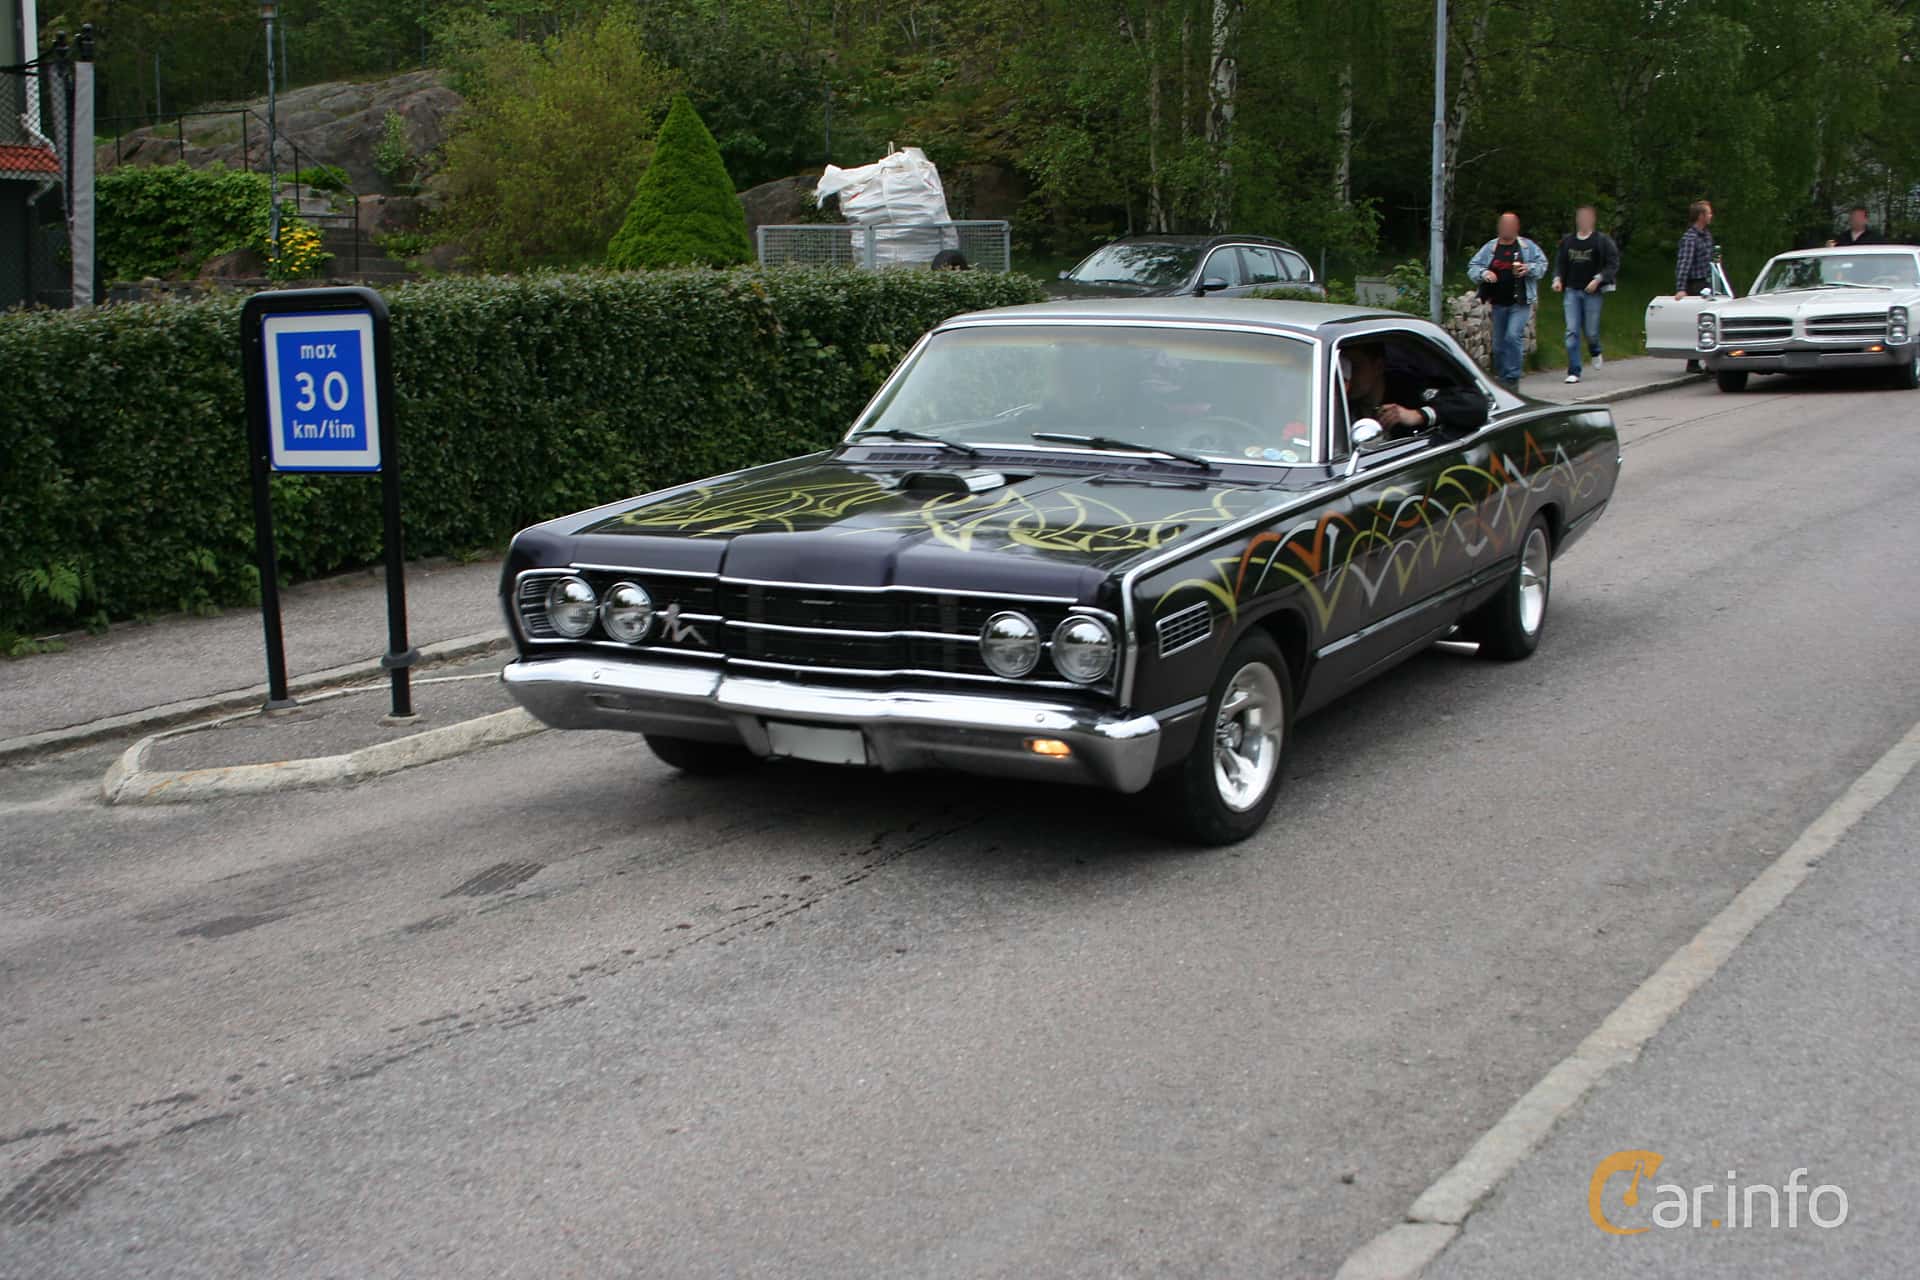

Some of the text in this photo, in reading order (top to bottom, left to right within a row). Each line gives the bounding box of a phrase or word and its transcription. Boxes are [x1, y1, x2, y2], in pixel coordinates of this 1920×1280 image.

[300, 343, 337, 360] max
[295, 370, 349, 412] 30
[293, 419, 356, 439] km/tim
